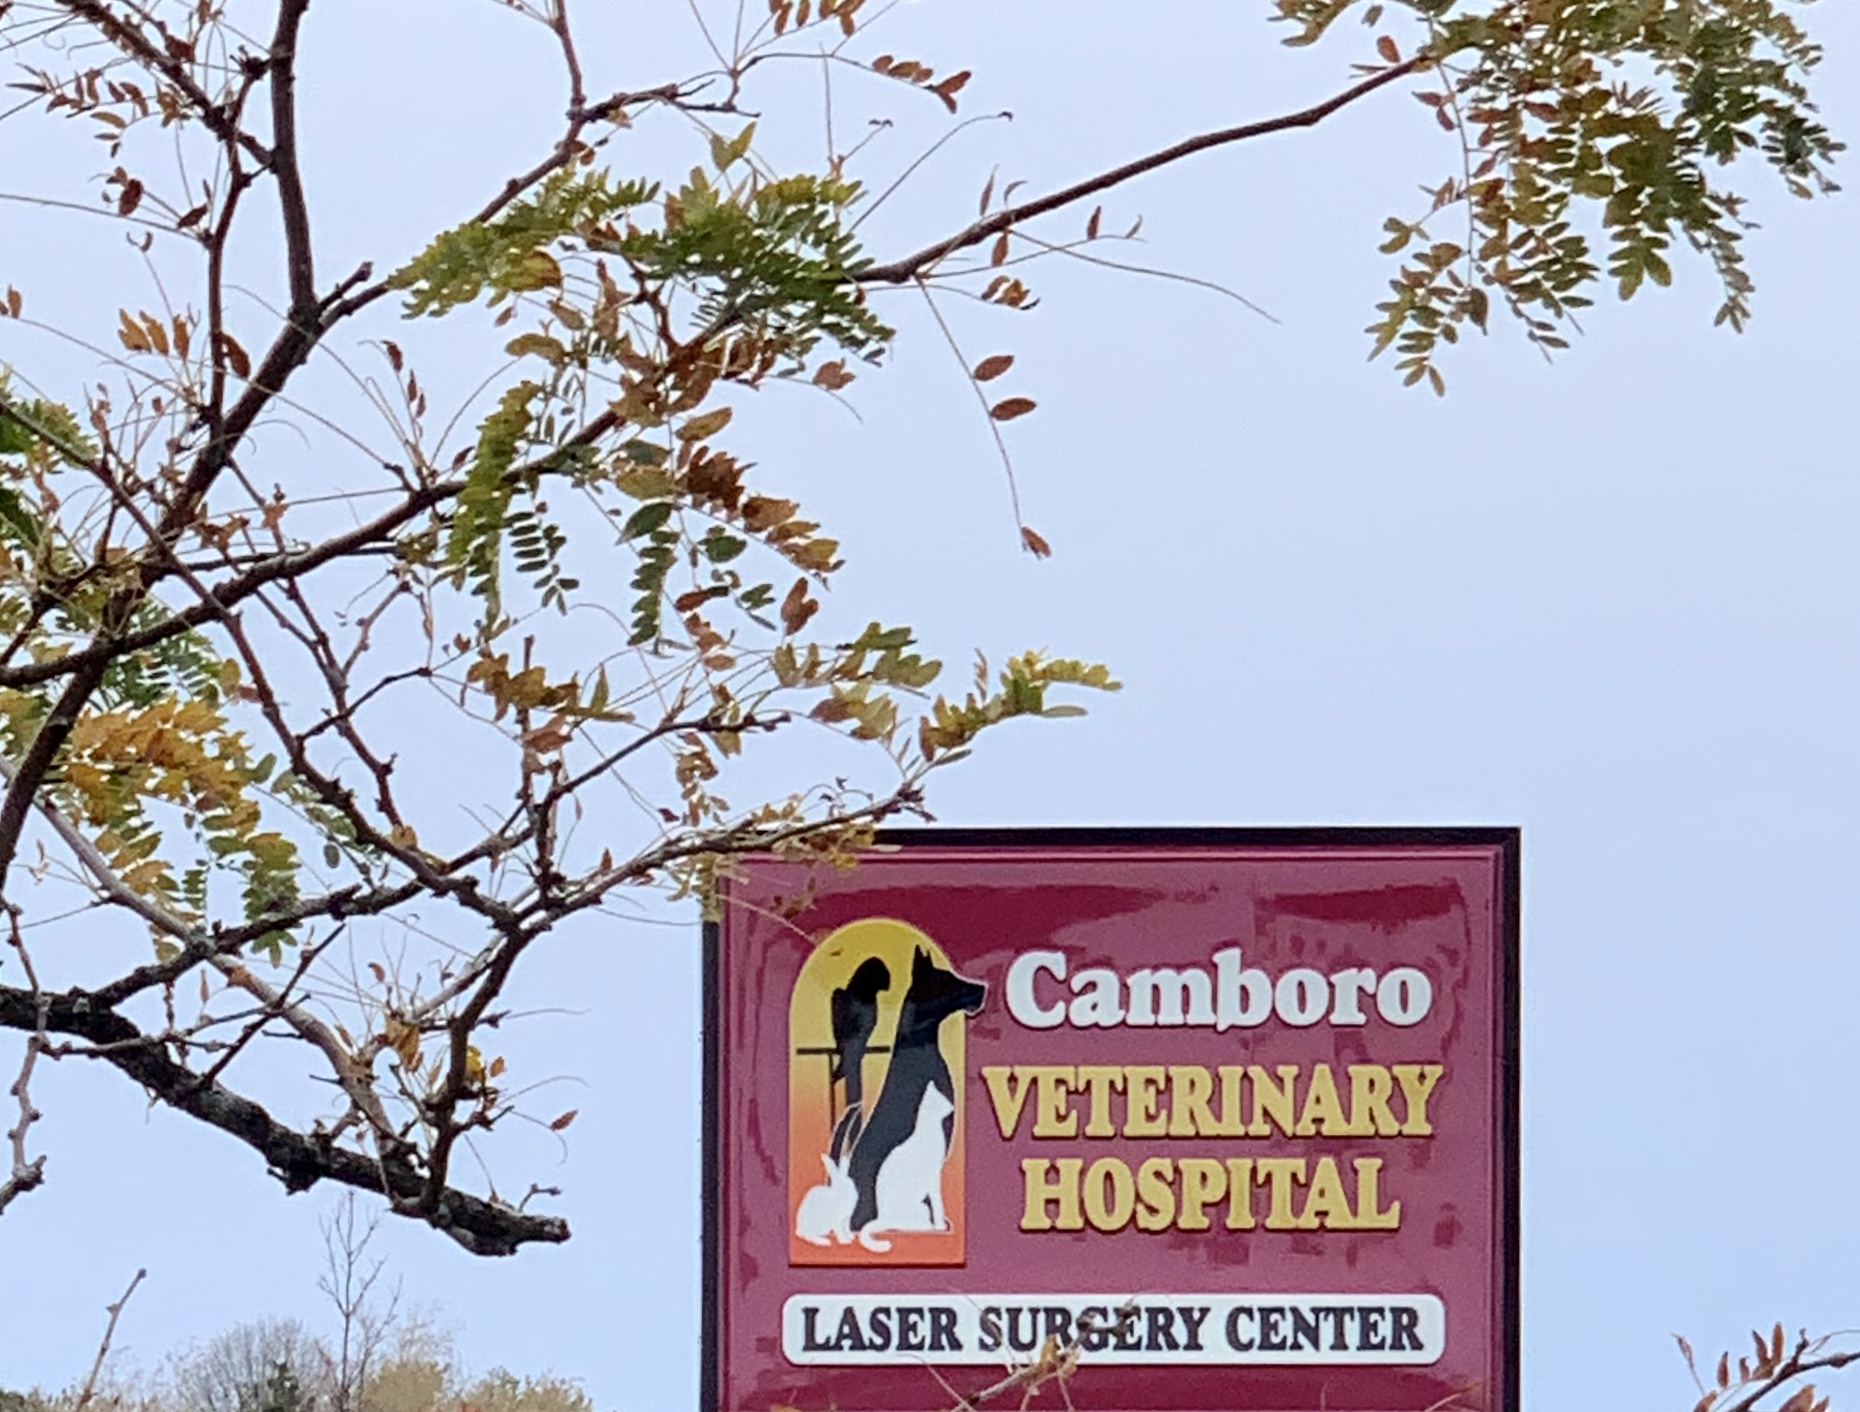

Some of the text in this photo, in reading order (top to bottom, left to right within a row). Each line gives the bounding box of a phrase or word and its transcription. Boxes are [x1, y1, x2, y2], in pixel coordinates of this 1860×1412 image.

[1005, 947, 1433, 1032] Camboro
[982, 1063, 1443, 1139] VETERINARY
[1020, 1157, 1401, 1231] HOSPITAL
[802, 1306, 1424, 1352] LASER SURGERY CENTER
